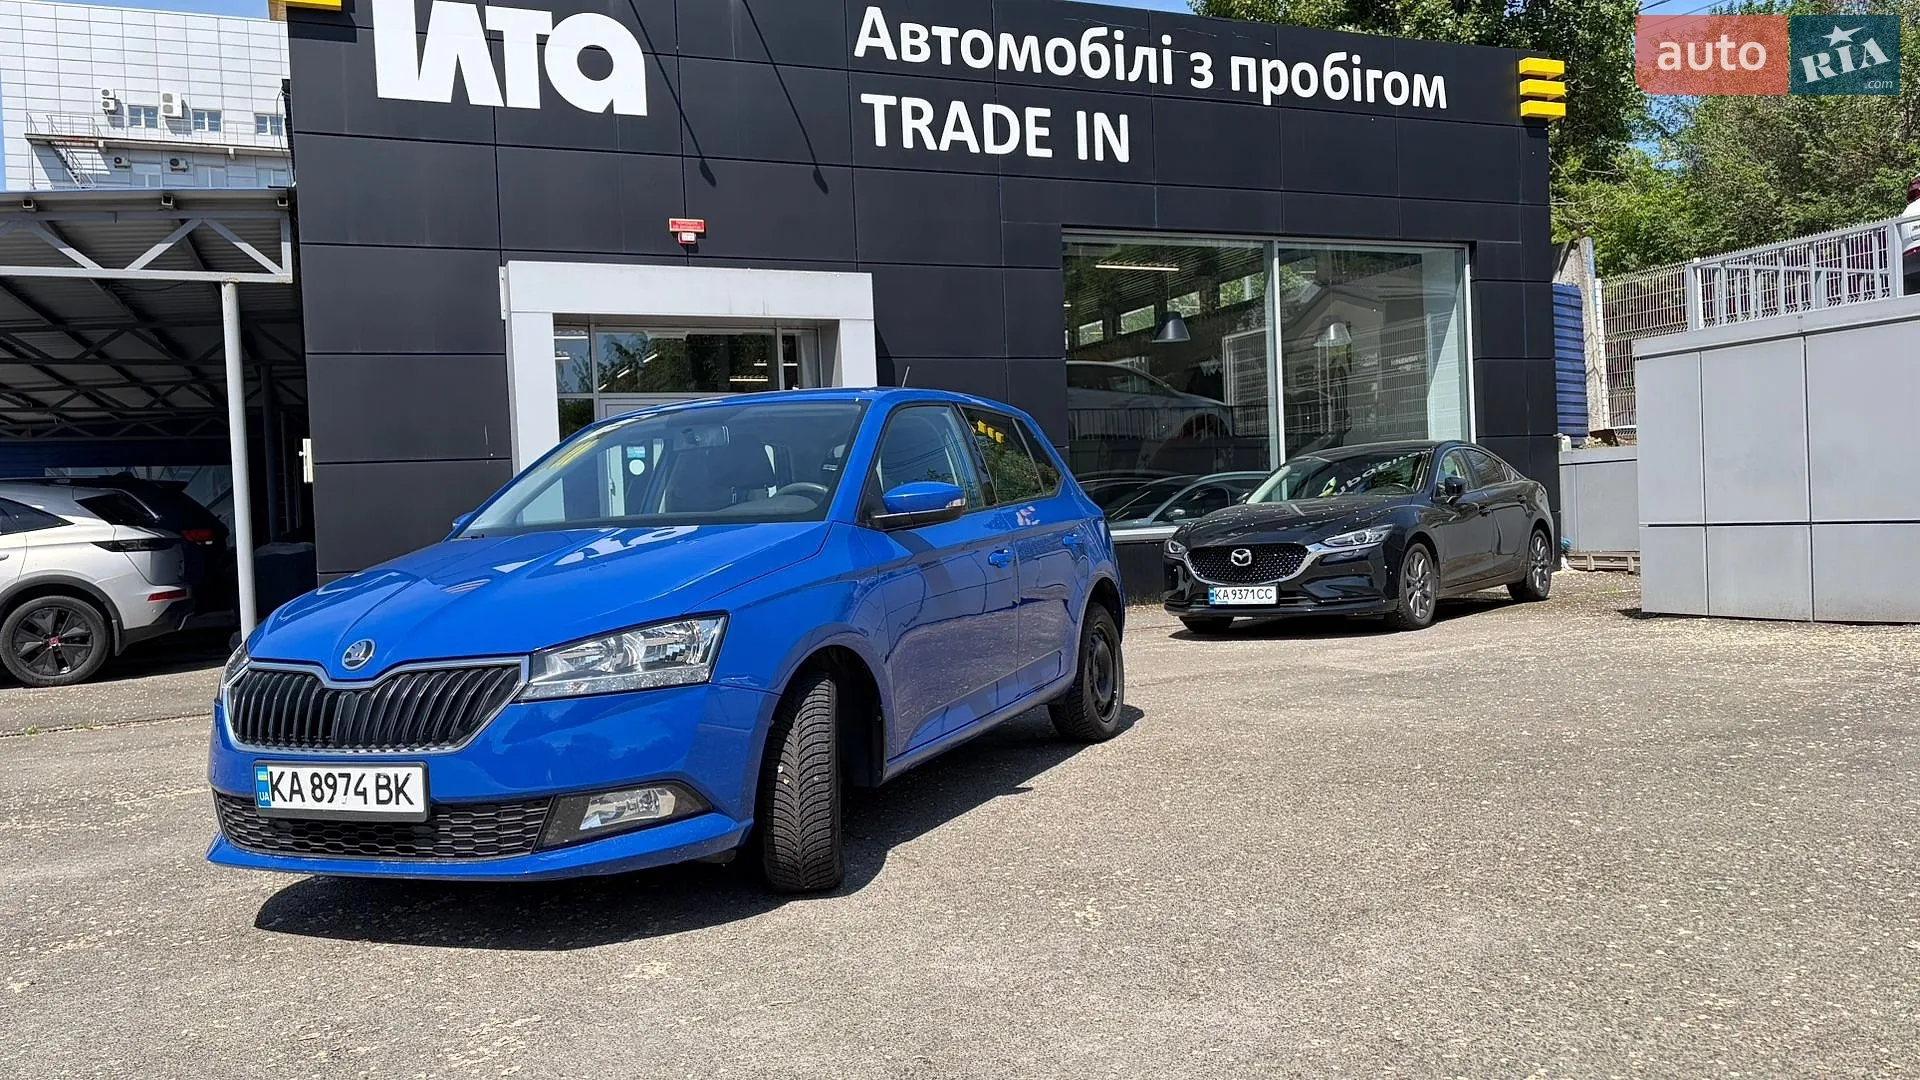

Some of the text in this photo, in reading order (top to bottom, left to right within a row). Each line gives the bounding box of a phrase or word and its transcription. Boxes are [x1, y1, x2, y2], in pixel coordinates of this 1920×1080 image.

[853, 6, 1448, 109] Автомобілі з пробігом
[860, 93, 1130, 163] TRADE IN
[269, 770, 415, 807] KA 8974 BK
